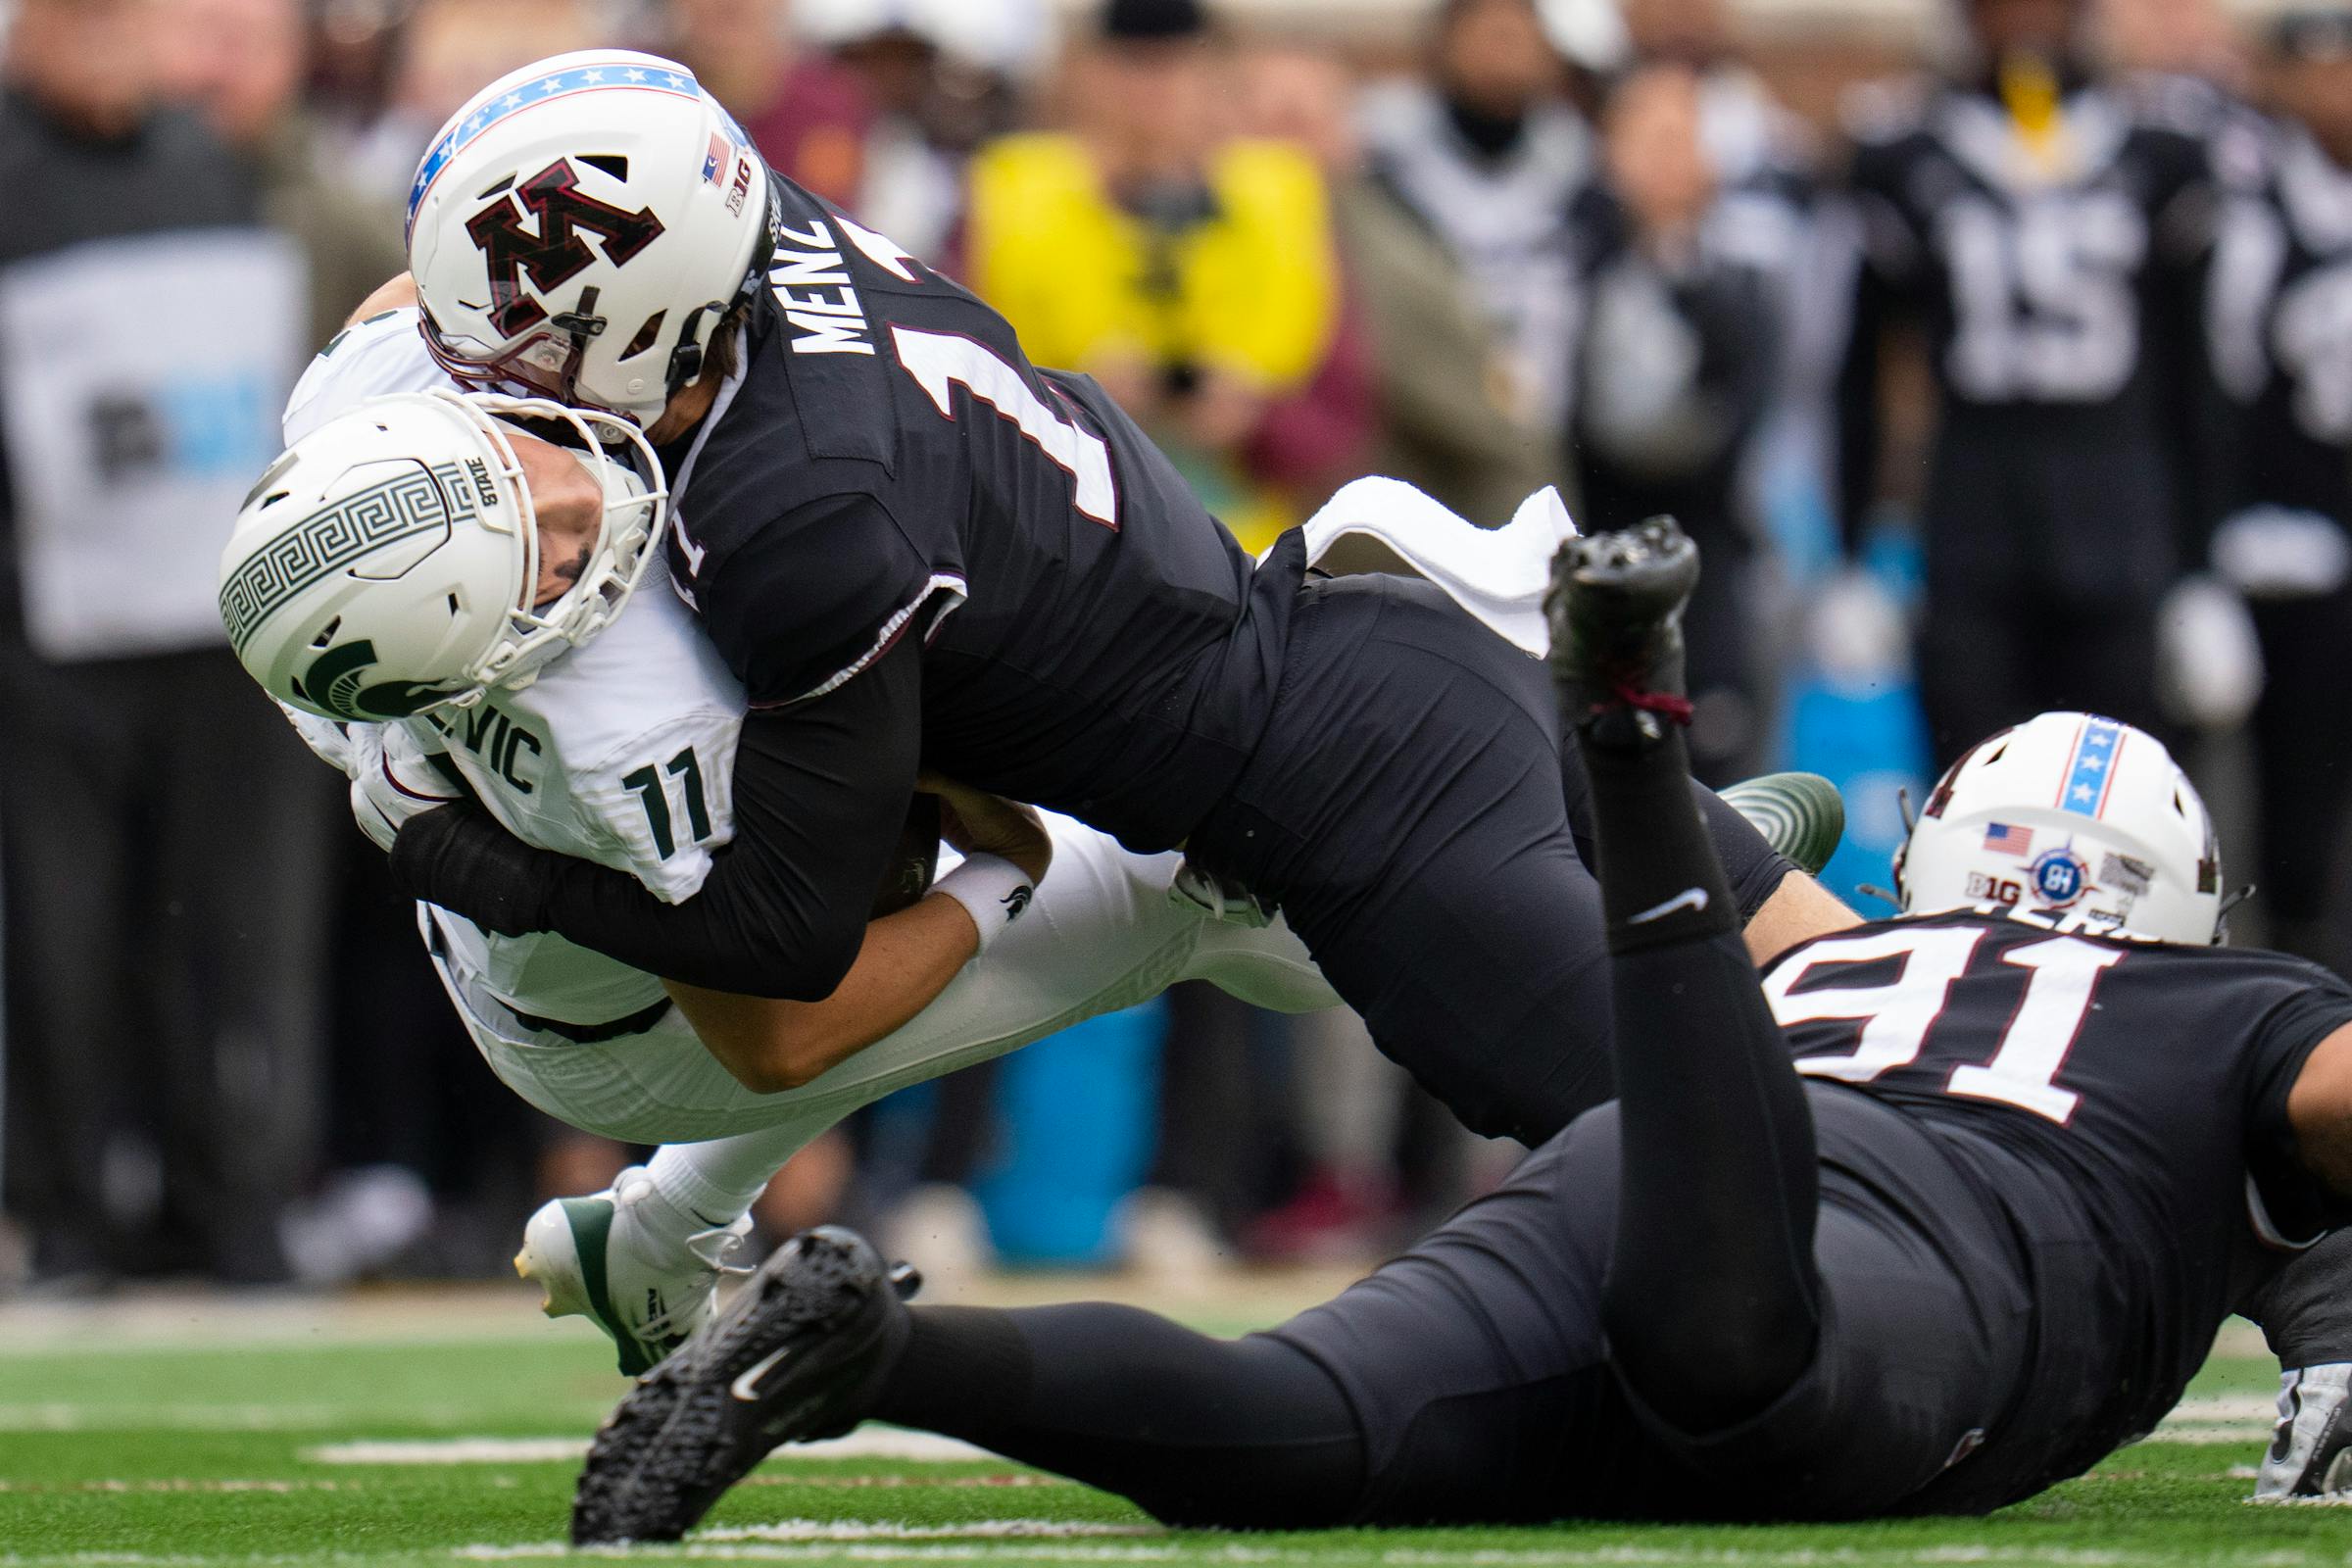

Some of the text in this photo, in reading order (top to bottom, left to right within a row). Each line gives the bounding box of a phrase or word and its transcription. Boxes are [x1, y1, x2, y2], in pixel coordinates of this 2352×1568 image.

[465, 156, 666, 341] M
[620, 744, 713, 862] 11
[1760, 926, 2129, 1127] 91
